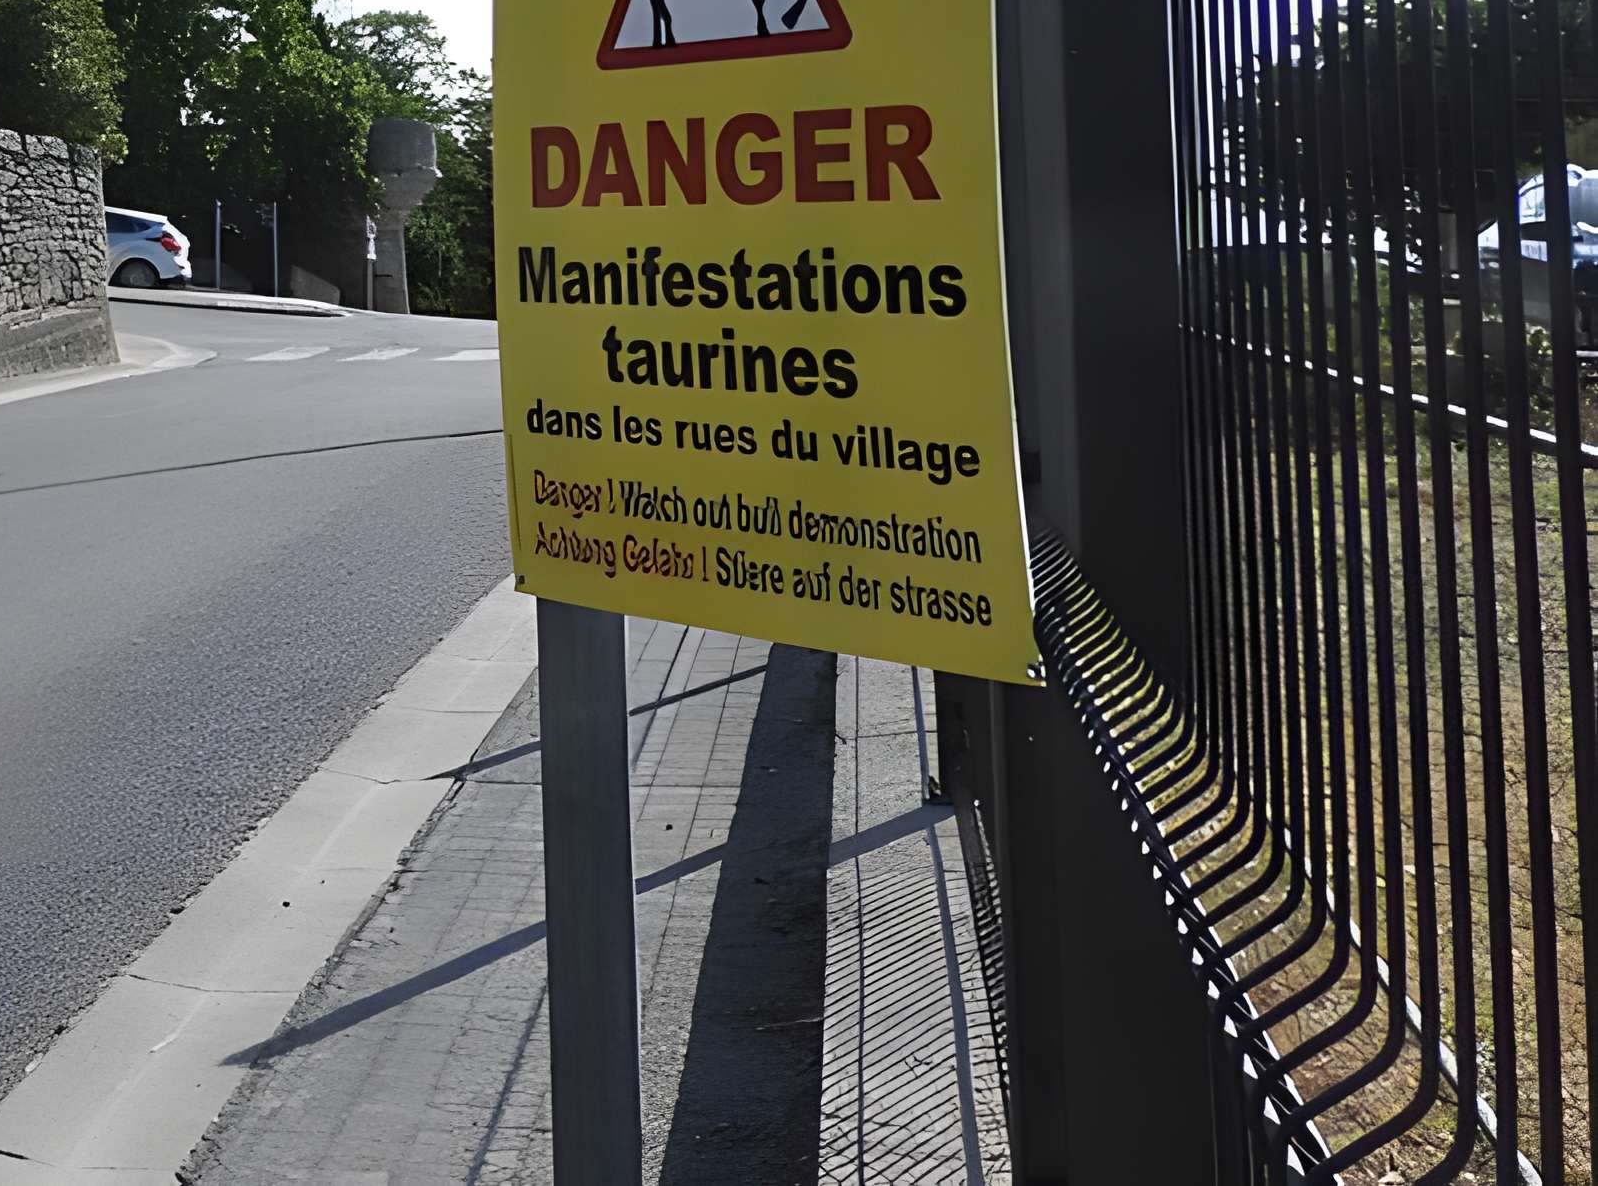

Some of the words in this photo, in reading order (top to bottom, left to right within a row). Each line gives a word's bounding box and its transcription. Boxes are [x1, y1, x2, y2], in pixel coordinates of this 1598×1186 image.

[530, 104, 942, 208] DANGER
[518, 246, 968, 318] Manifestations
[602, 325, 859, 400] taurines
[527, 398, 603, 442] dans
[613, 405, 662, 446] les
[675, 420, 758, 457] rues
[771, 418, 819, 463] du
[832, 424, 981, 487] village
[788, 499, 982, 564] demonstration
[792, 562, 832, 602] auf
[839, 565, 882, 611] der
[890, 575, 993, 627] strasse
